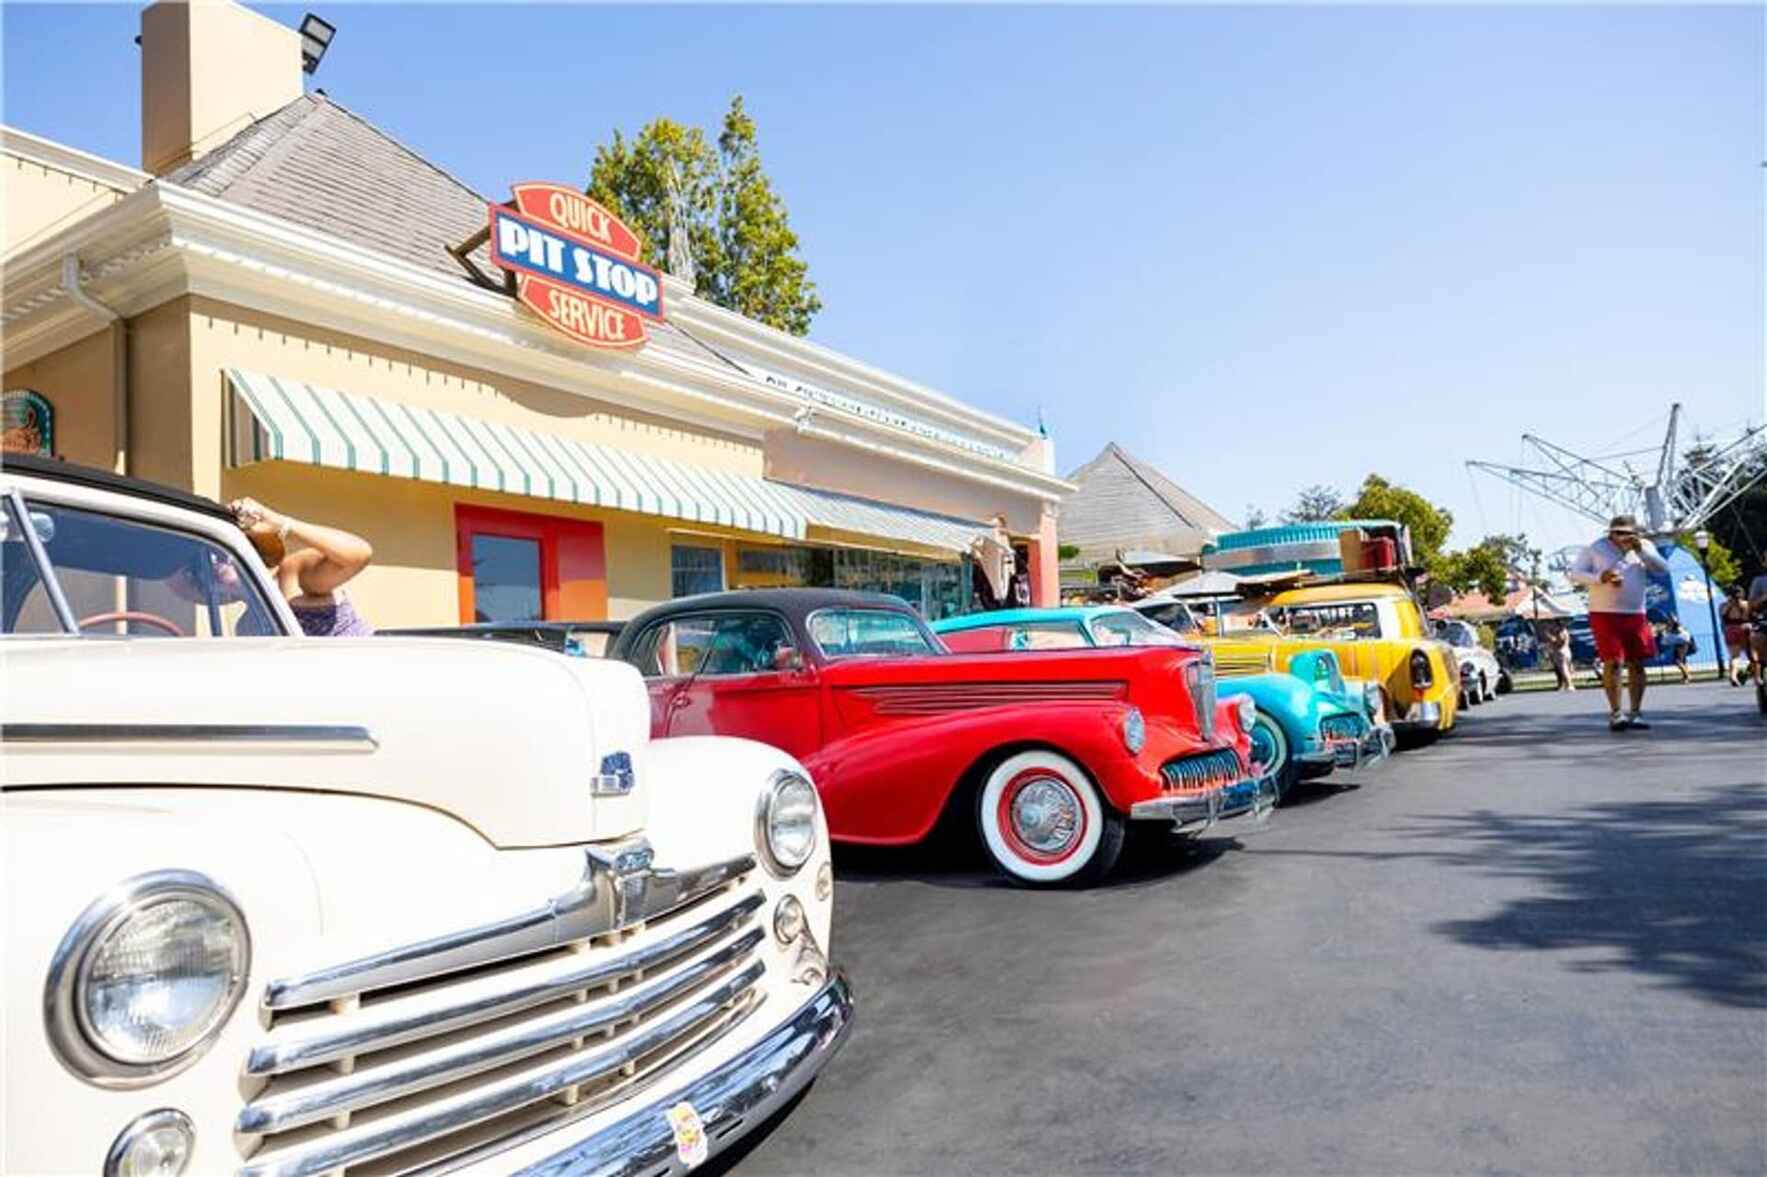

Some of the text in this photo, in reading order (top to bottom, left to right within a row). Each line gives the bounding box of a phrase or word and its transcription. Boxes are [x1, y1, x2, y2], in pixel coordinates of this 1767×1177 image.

[550, 192, 612, 244] QUICK
[499, 217, 658, 305] PIT STOP
[548, 289, 624, 340] SERVICE
